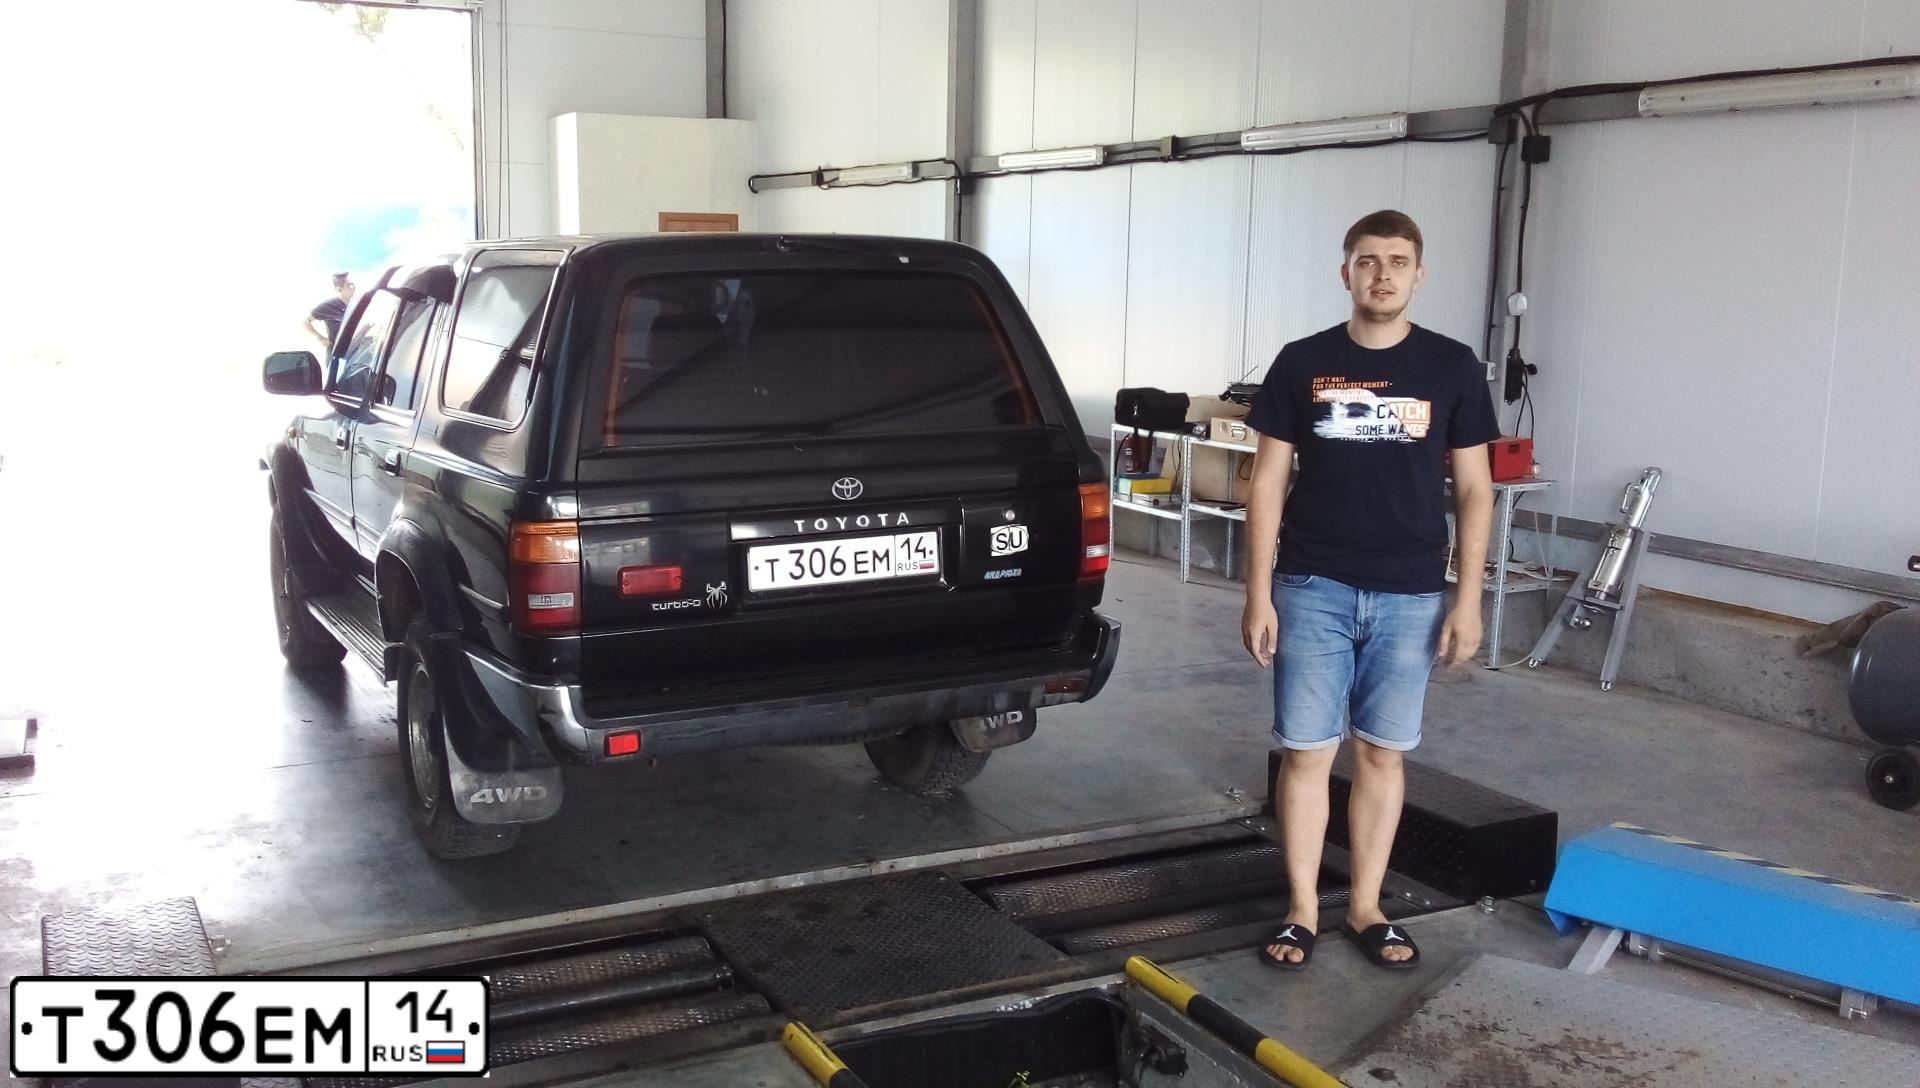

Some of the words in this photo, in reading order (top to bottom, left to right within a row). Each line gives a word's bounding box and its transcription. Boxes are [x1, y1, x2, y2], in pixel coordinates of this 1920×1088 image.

[1362, 380, 1388, 388] MOMENT
[1376, 402, 1427, 420] CATCH
[1355, 425, 1383, 436] SOME
[1387, 424, 1426, 436] WAVES
[794, 512, 909, 532] TOYOTA
[996, 530, 1022, 550] SU
[765, 546, 890, 582] Т306ЕМ
[900, 536, 927, 560] 14
[897, 562, 919, 571] RUS
[470, 786, 547, 803] 4WD
